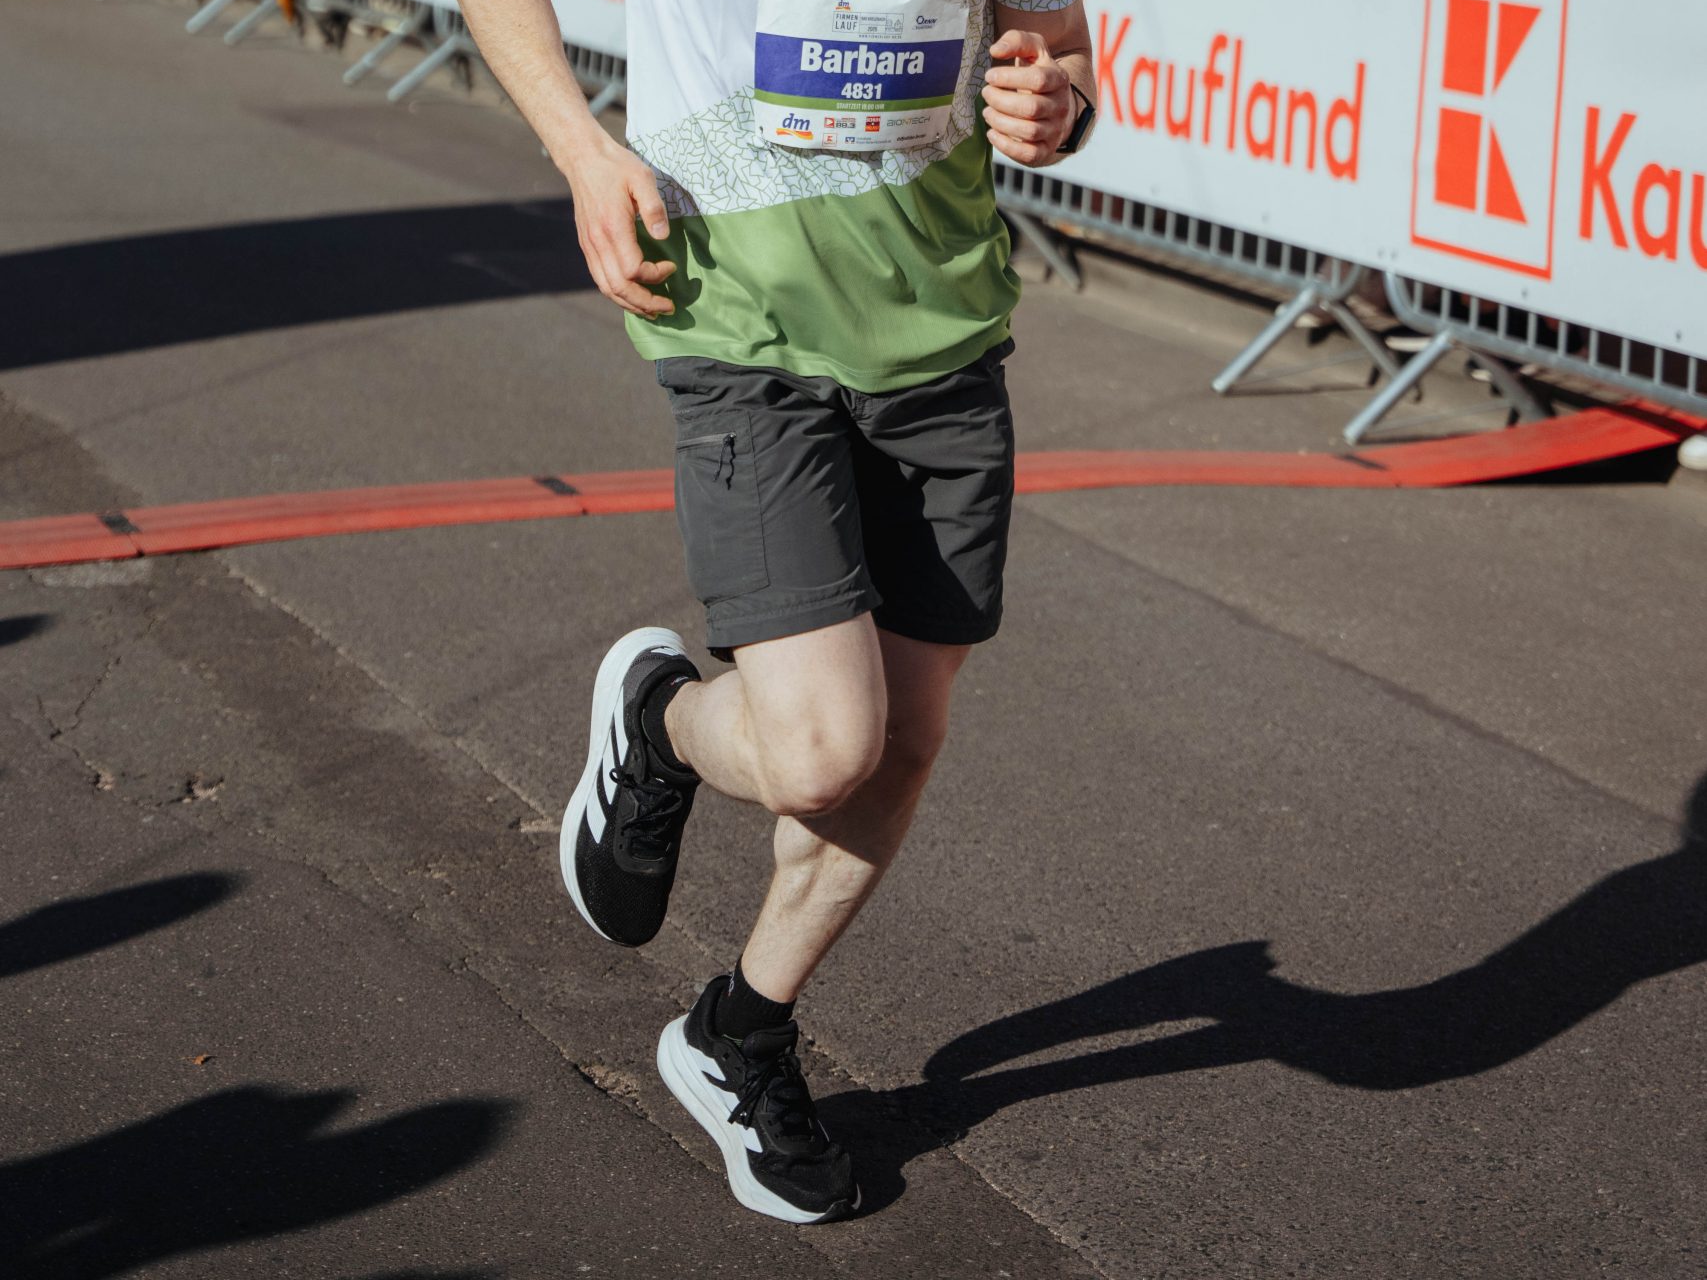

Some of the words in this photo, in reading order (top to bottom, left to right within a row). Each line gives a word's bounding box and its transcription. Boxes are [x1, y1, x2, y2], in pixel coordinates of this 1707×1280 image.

[835, 13, 859, 21] FIRMEN
[835, 21, 858, 31] LAUF
[800, 41, 925, 76] Barbara
[841, 82, 882, 100] 4831
[1097, 11, 1367, 183] Kaufland
[782, 113, 811, 131] dm
